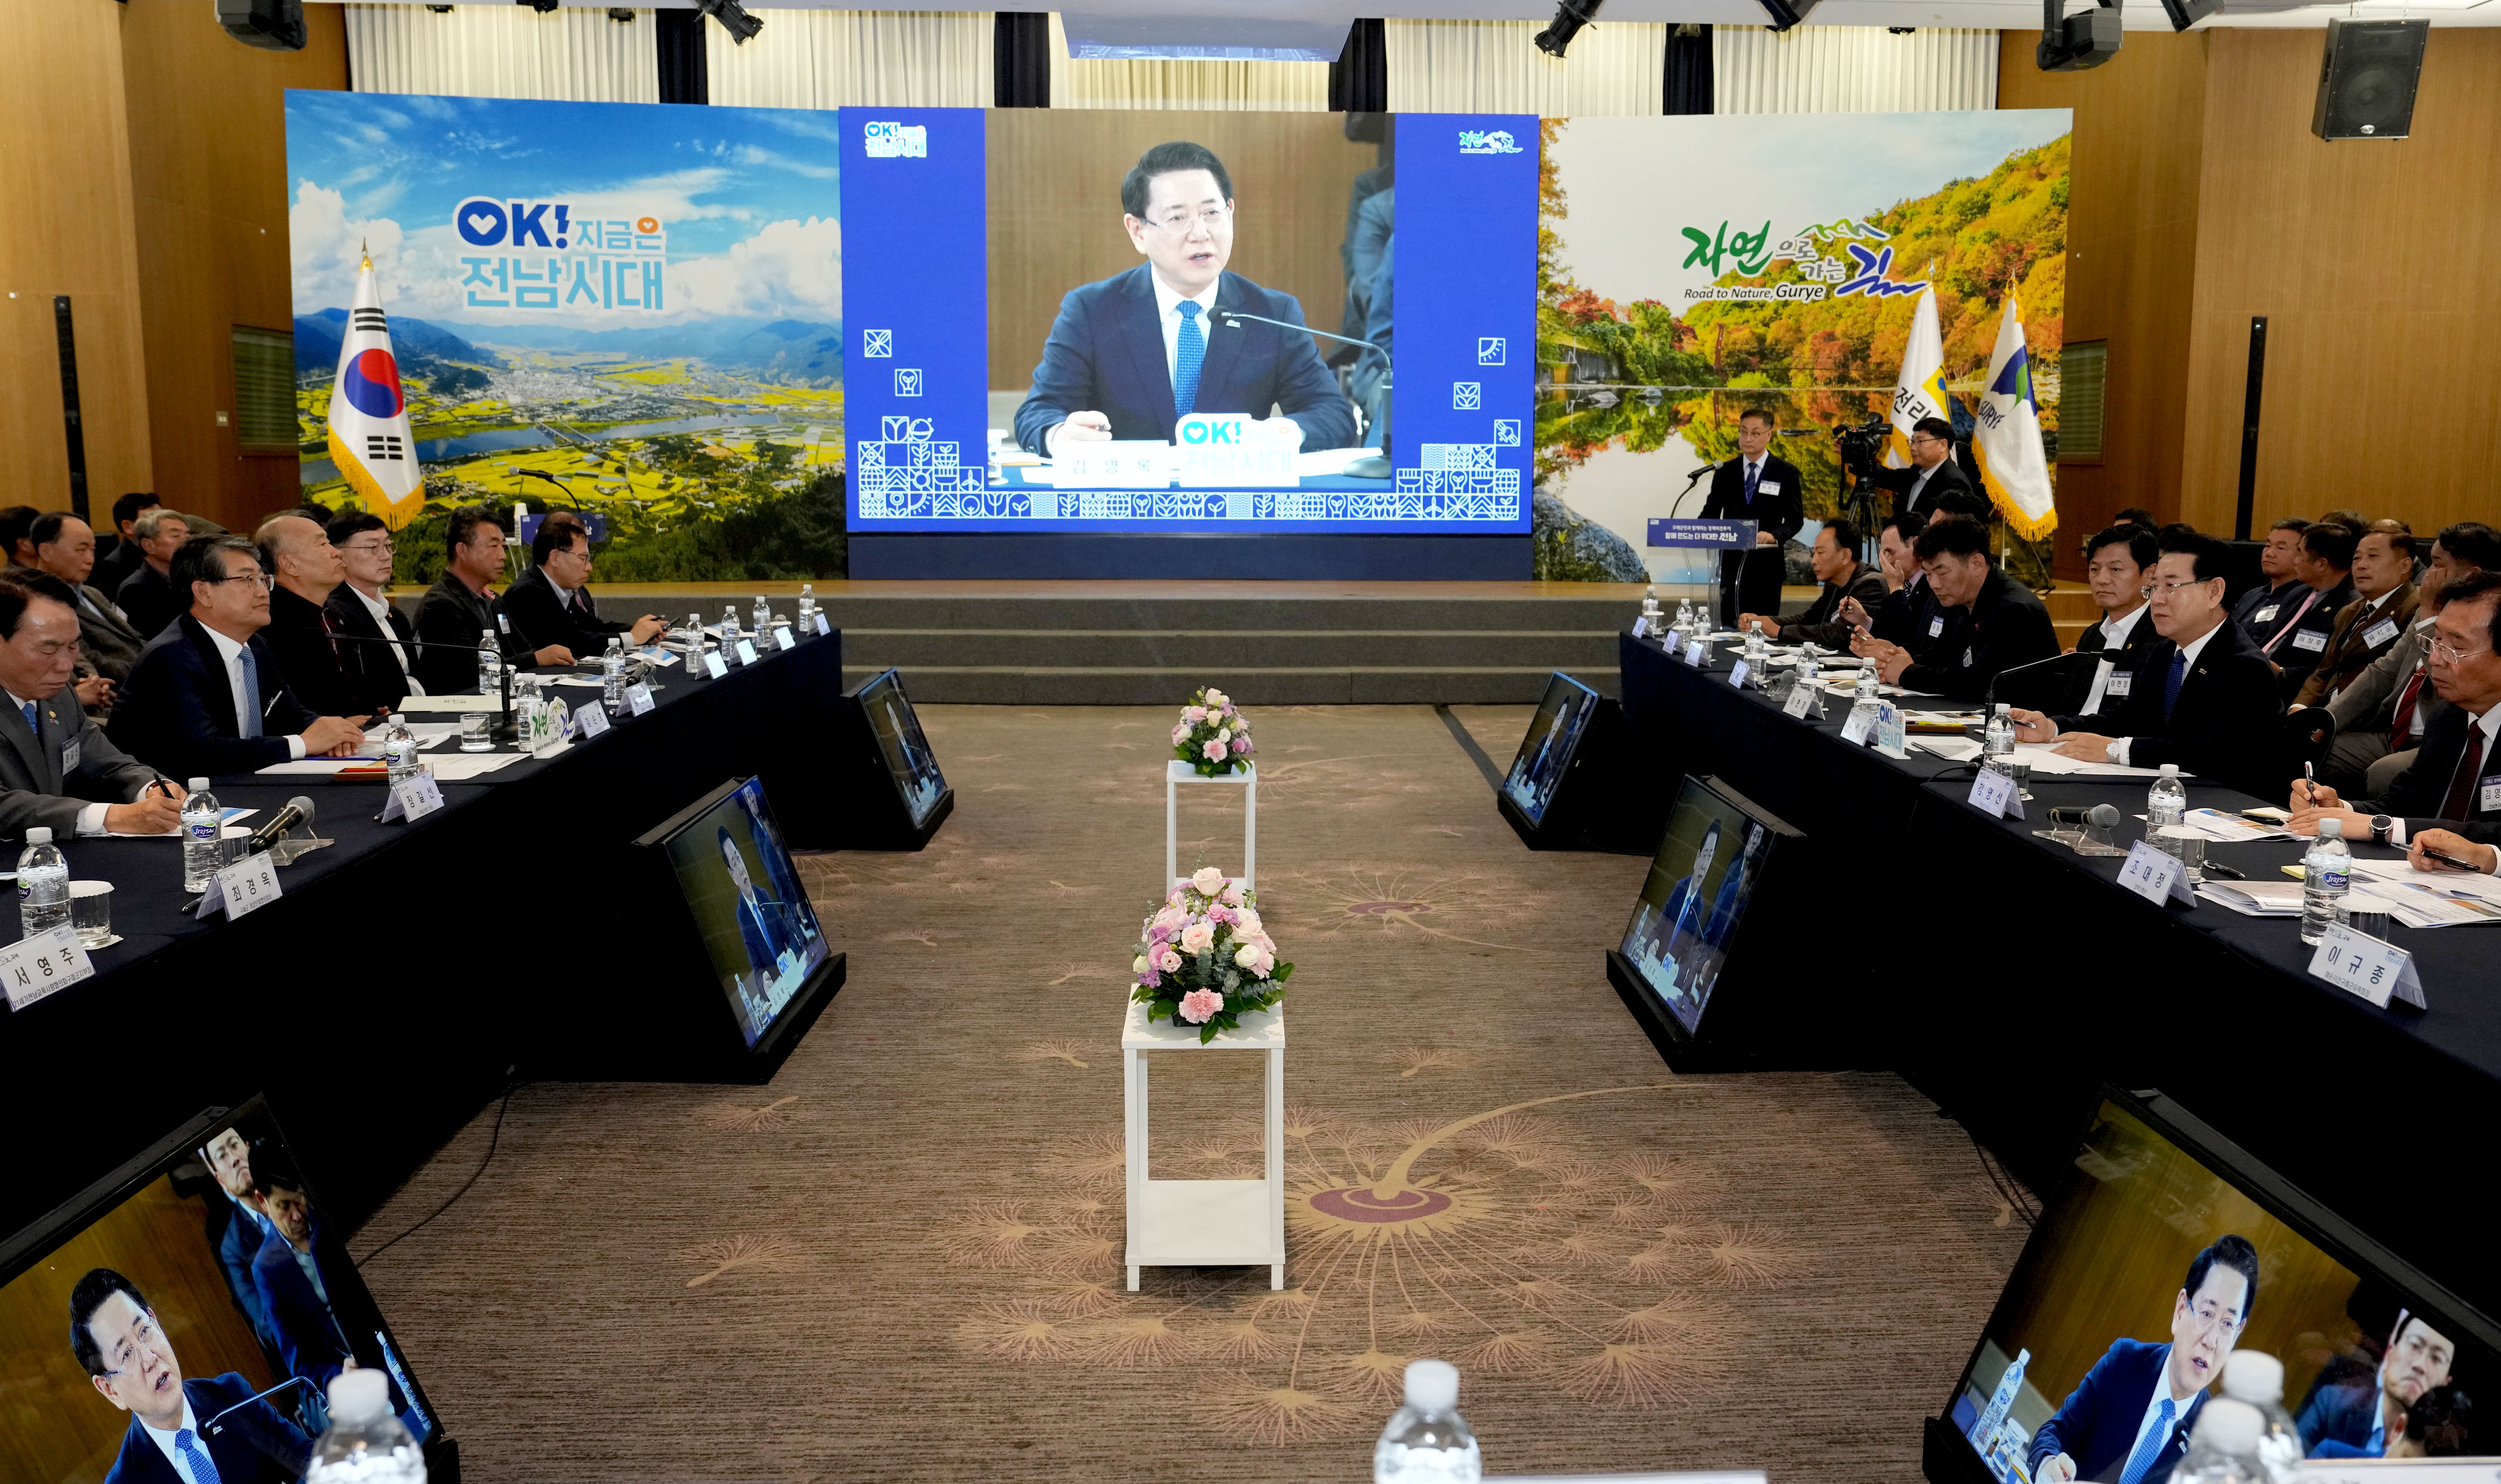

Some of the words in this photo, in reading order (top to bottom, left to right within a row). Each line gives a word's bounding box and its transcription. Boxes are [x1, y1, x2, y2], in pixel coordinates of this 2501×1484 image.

[867, 124, 898, 137] OK!
[458, 201, 570, 249] OK!
[576, 217, 662, 250] 지금은
[1801, 258, 1846, 279] 가는
[461, 257, 663, 310] 전남시대
[1685, 288, 1714, 298] Road
[1717, 289, 1728, 298] to
[1731, 288, 1773, 299] Nature,
[1776, 284, 1823, 301] Gurye
[1183, 421, 1241, 444] OK!
[1719, 532, 1738, 542] 전남
[554, 722, 561, 733] 가는
[1880, 705, 1892, 725] OK!
[1892, 715, 1902, 729] 지금은
[1879, 725, 1902, 752] 전남시대
[406, 786, 435, 808] 장길선
[1977, 783, 2003, 805] 김영선
[2129, 860, 2166, 888] 조대정
[2326, 875, 2348, 884] JIRISAN
[232, 872, 271, 902] 최경옥
[15, 947, 74, 986] 서영주
[778, 956, 789, 974] OK!
[1662, 956, 1673, 973] OK!
[2328, 946, 2385, 985] 이규종
